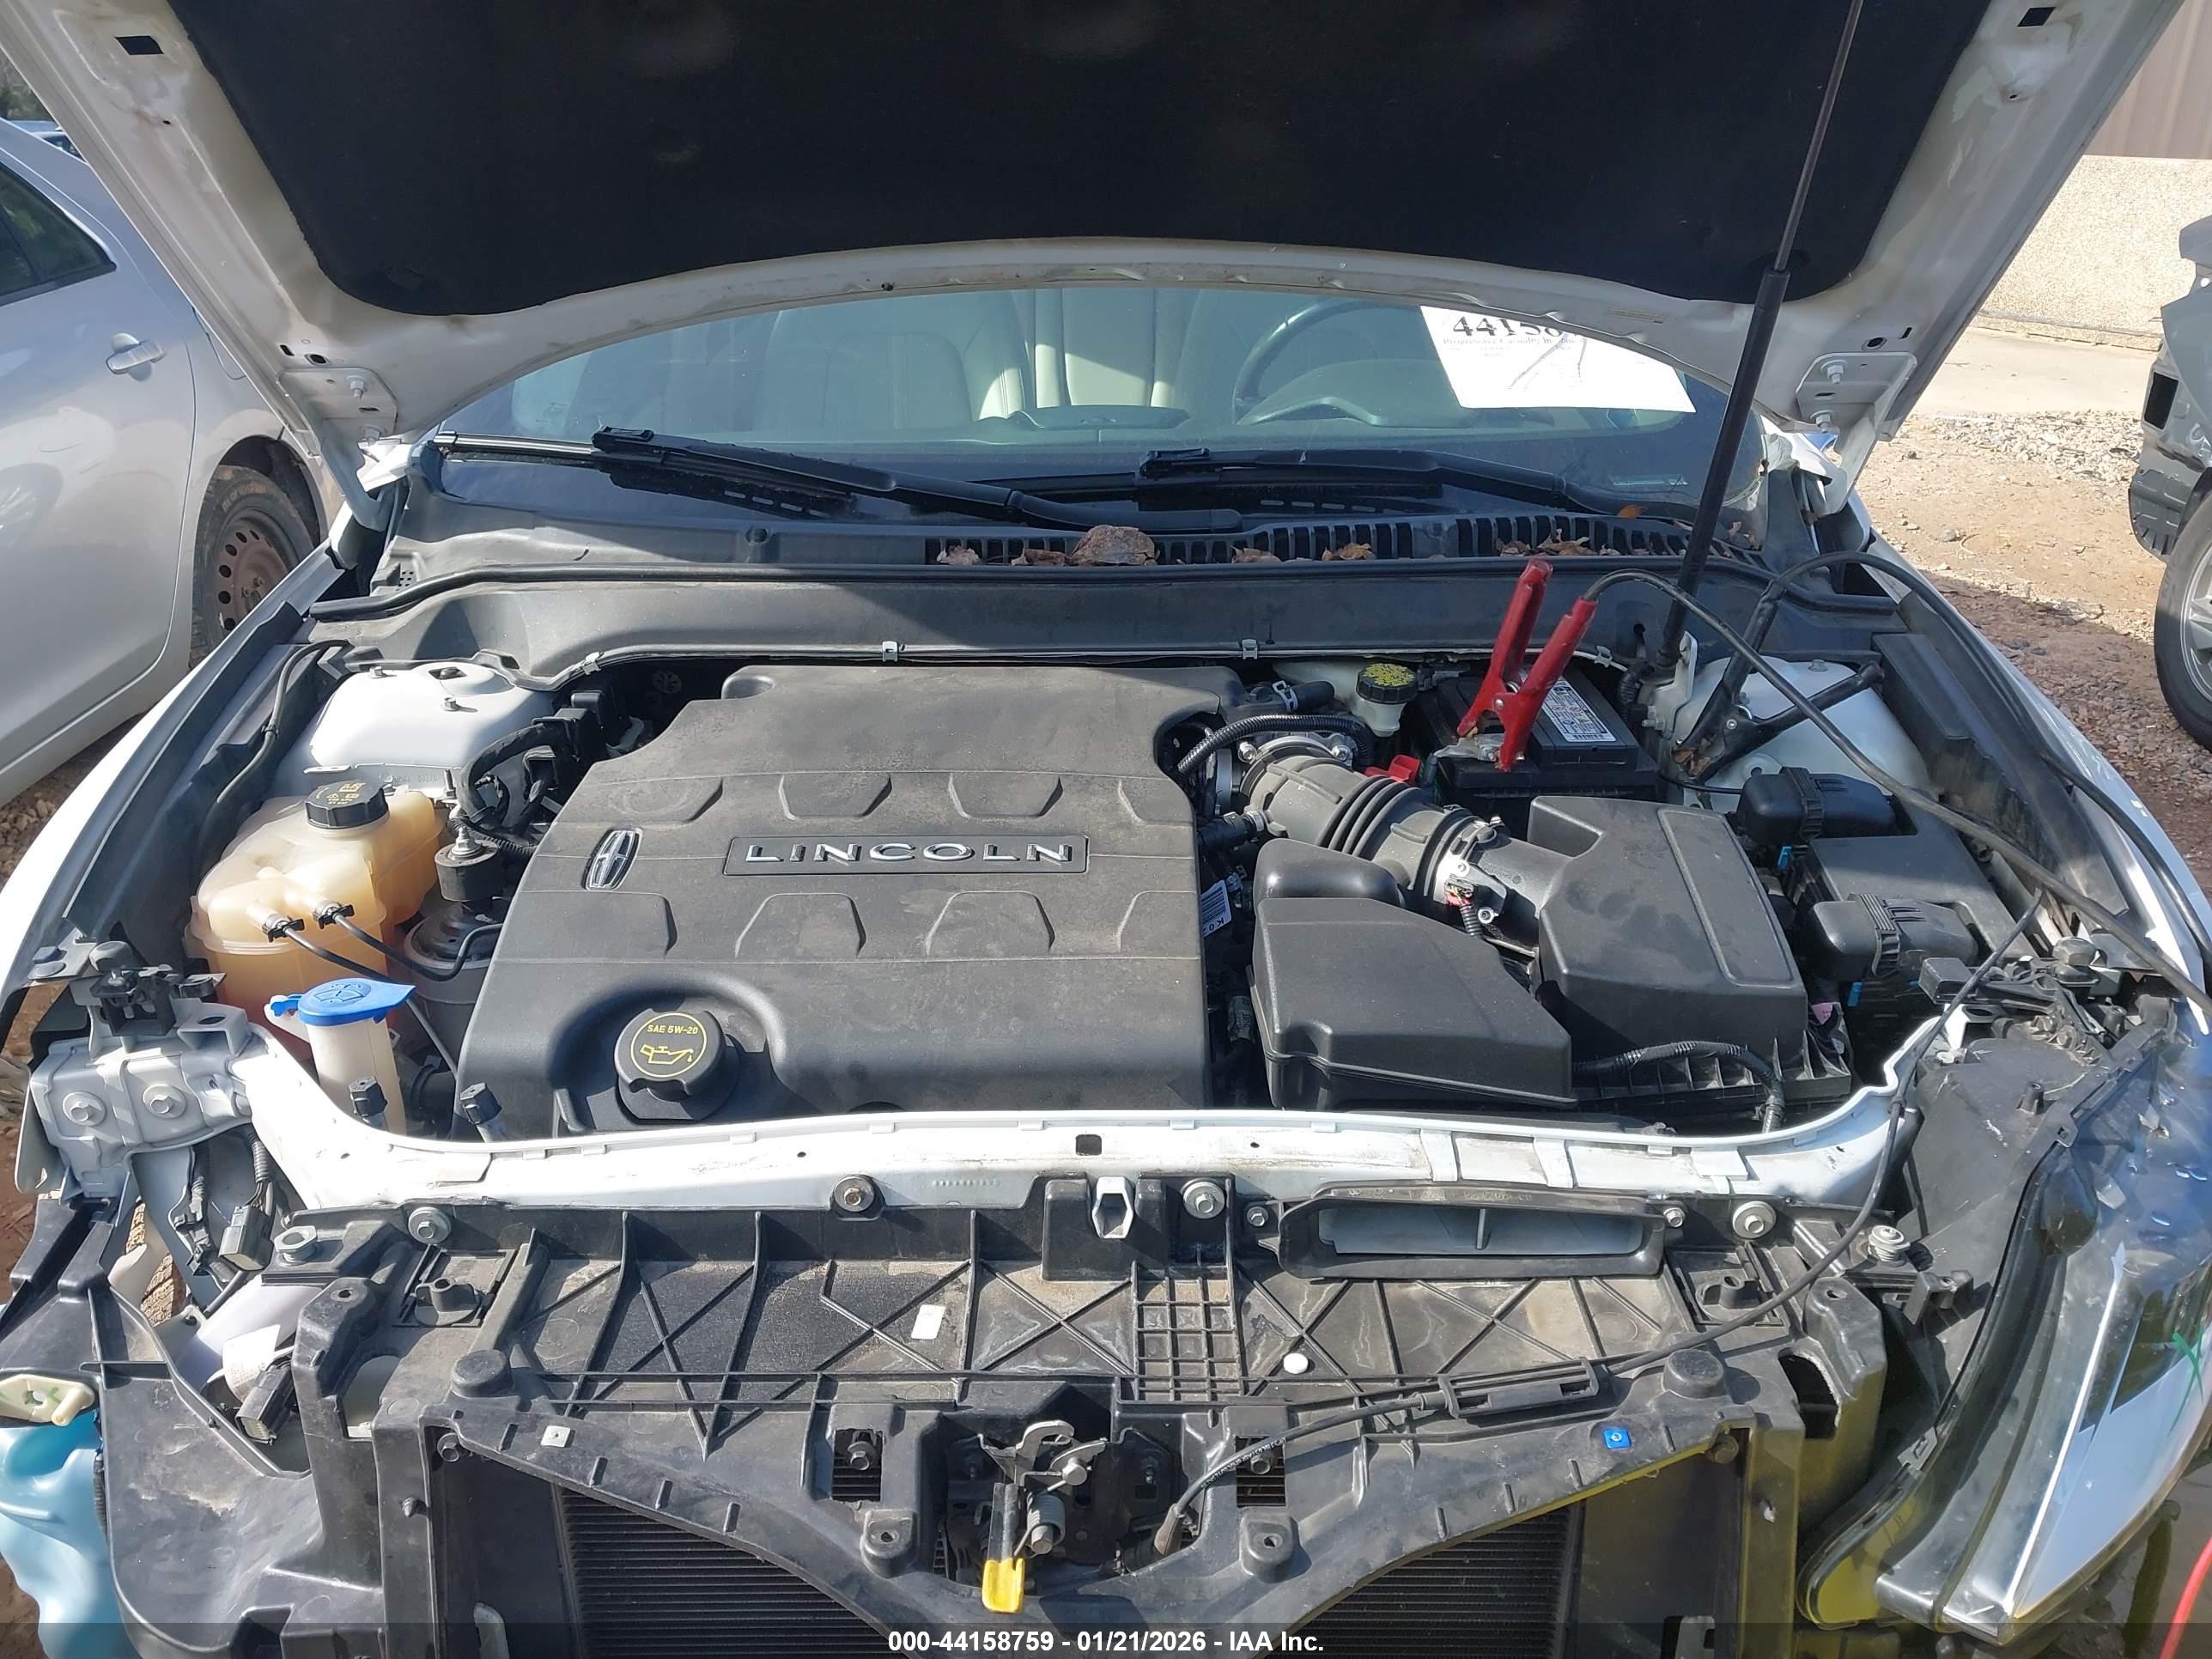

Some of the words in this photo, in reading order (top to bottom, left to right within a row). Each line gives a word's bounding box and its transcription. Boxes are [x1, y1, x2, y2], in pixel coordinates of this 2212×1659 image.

[745, 842, 1073, 865] LINCOLN
[647, 1024, 666, 1033] SAE
[667, 1025, 699, 1035] 5W-20
